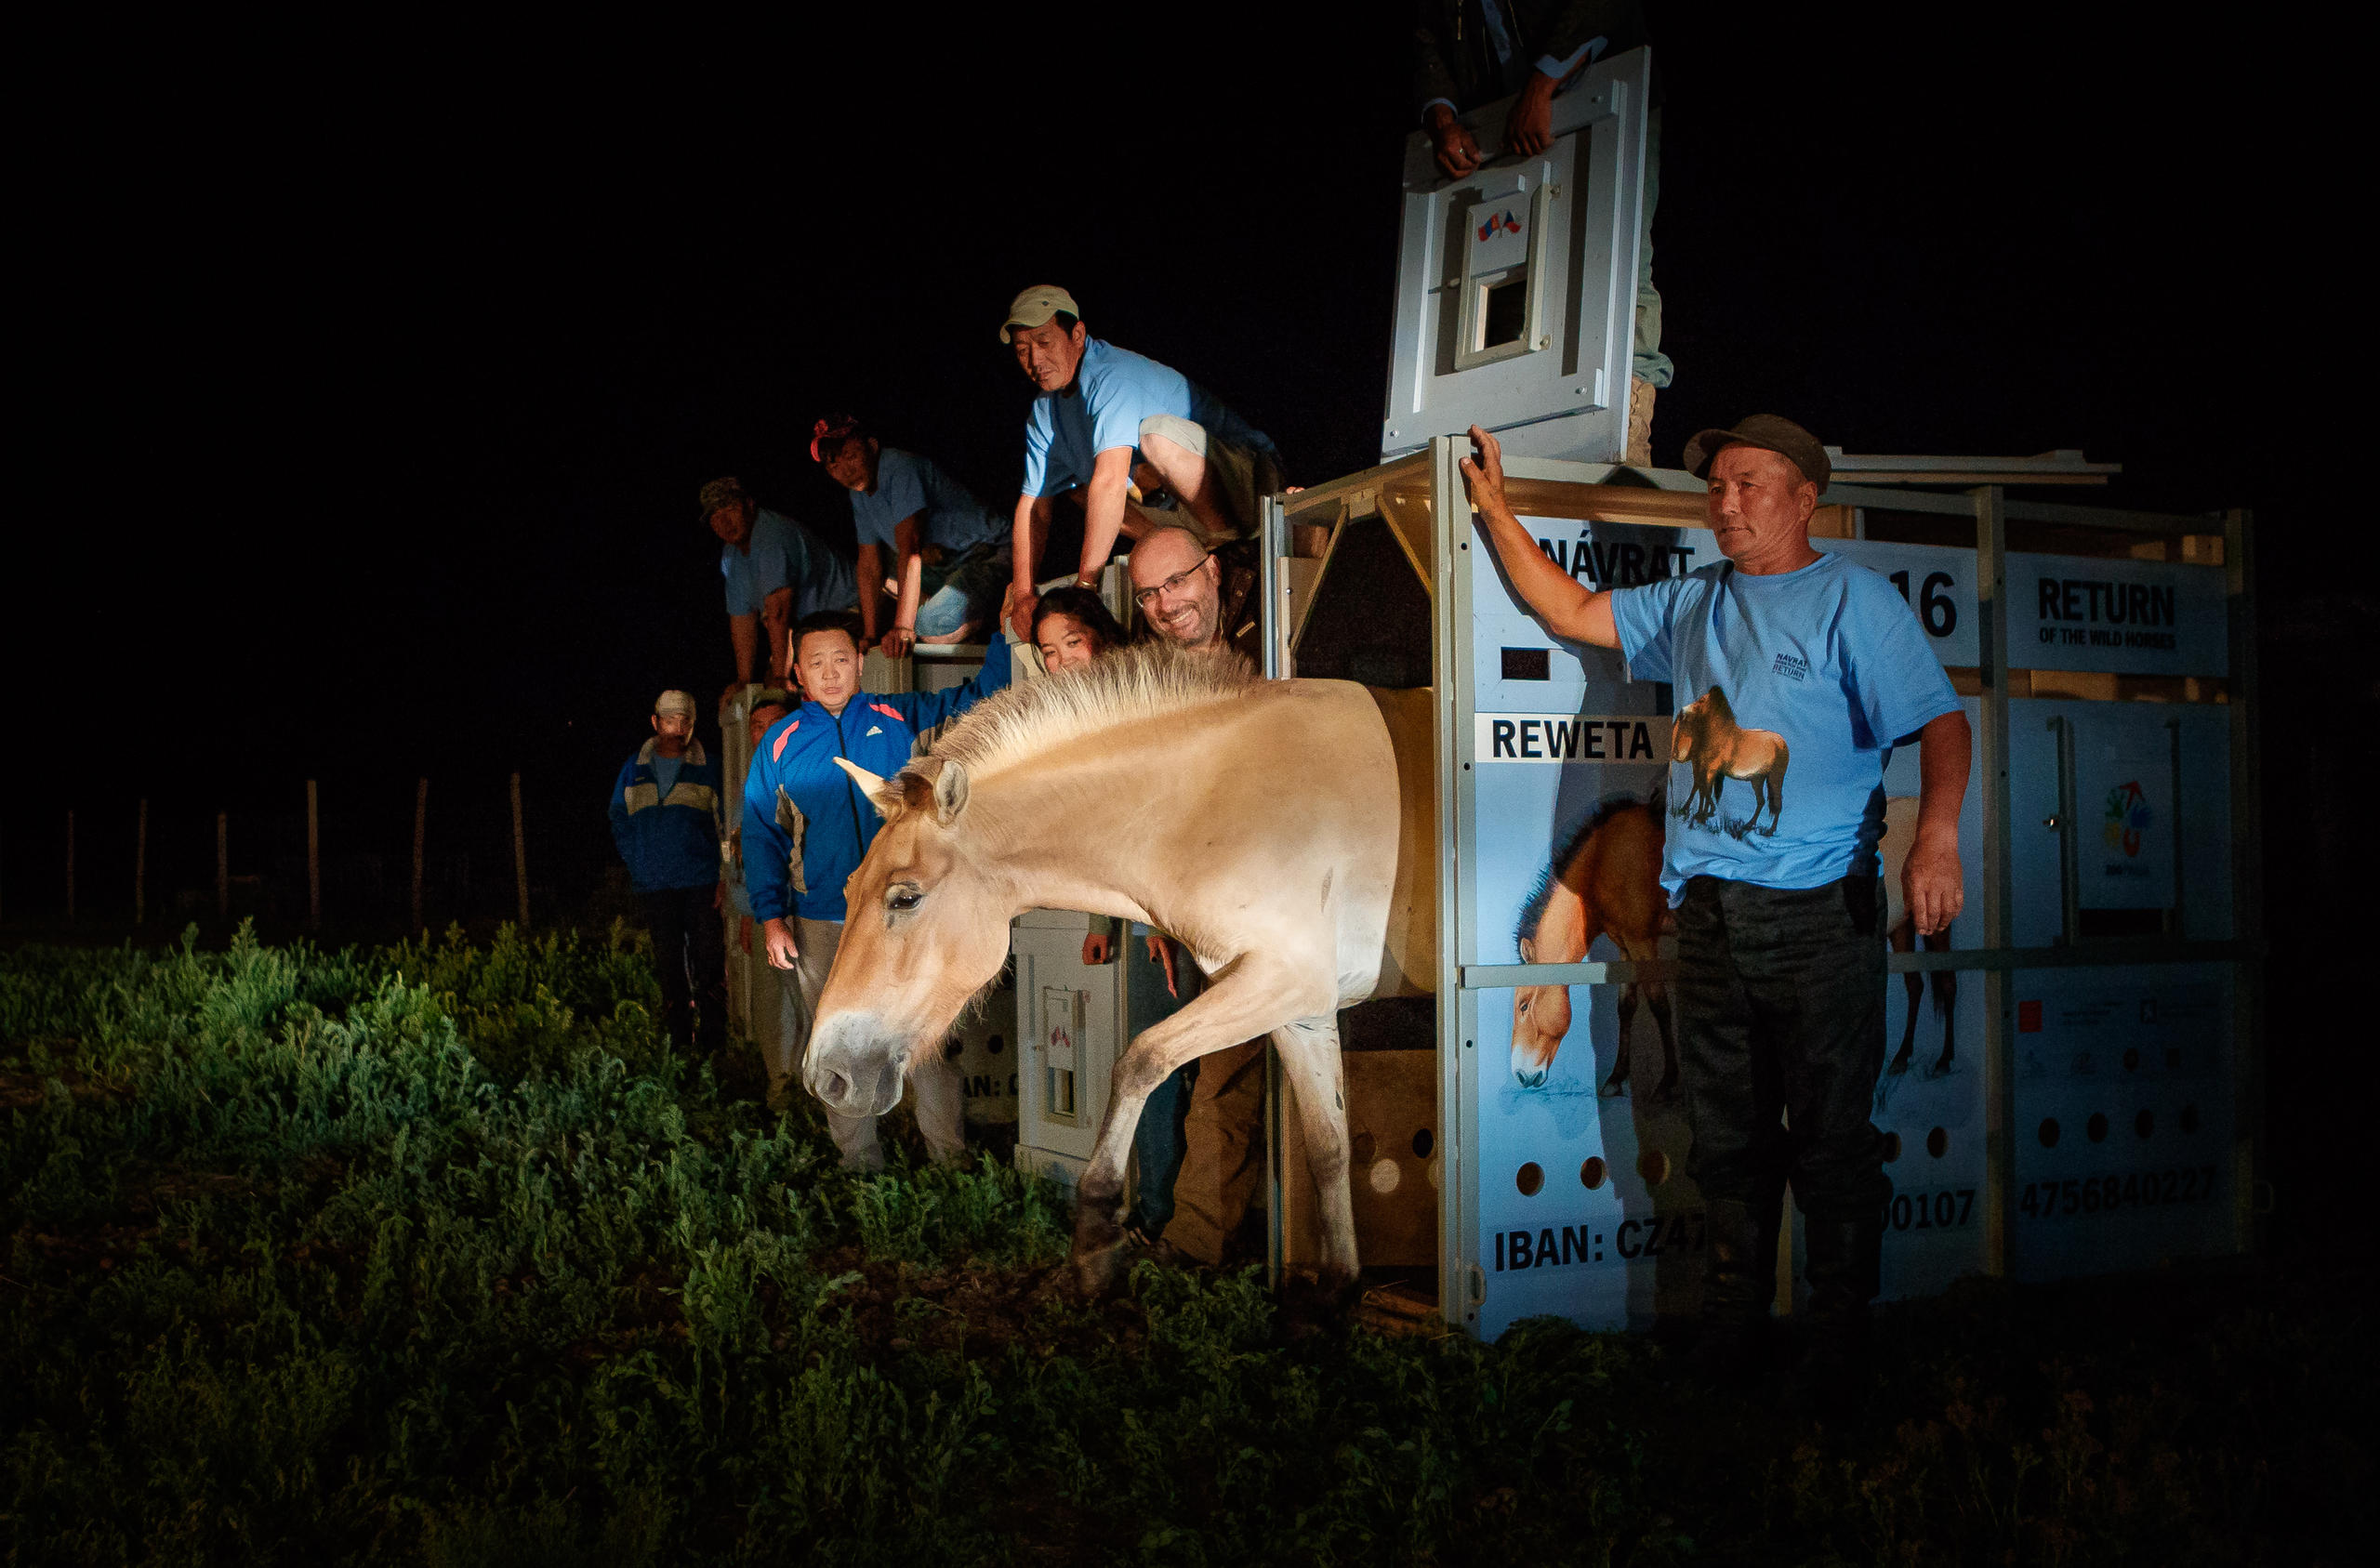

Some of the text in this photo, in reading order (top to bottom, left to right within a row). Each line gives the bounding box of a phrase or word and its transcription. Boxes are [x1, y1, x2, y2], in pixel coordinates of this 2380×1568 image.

[1539, 530, 1695, 584] NÁVRAT
[2039, 578, 2175, 626] RETURN
[2040, 626, 2175, 650] OF THE WILD HORSES
[1772, 664, 1805, 679] RETURN
[1493, 719, 1654, 758] REWETA
[2020, 1166, 2217, 1219] 4756840227
[1495, 1213, 1706, 1272] IBAN: CZ47
